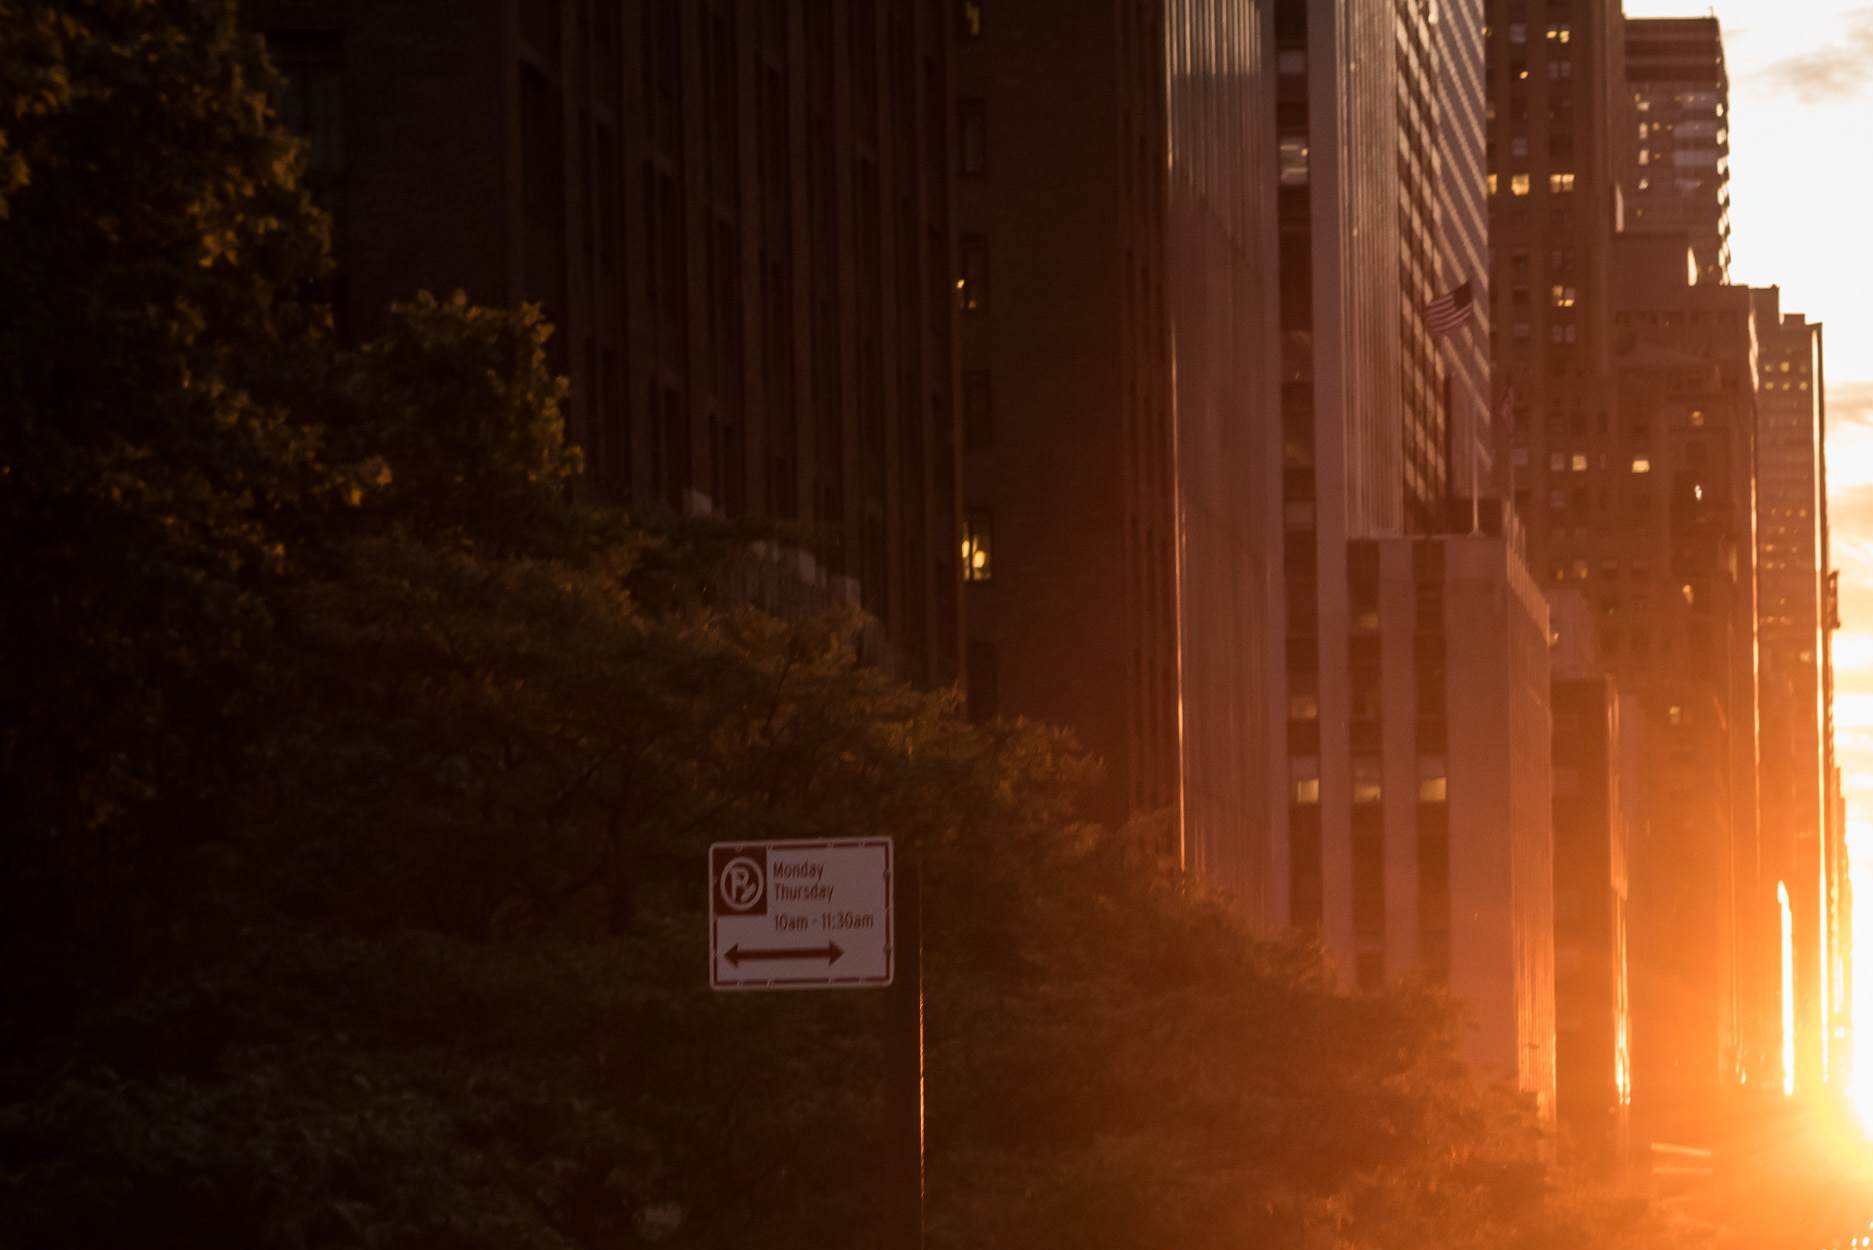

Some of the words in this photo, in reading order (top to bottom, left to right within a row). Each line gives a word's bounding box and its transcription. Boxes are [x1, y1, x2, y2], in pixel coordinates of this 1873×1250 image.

[773, 861, 824, 881] Monday
[775, 884, 834, 902] Thursday
[775, 914, 808, 930] 10am
[822, 911, 874, 930] 11:30am
